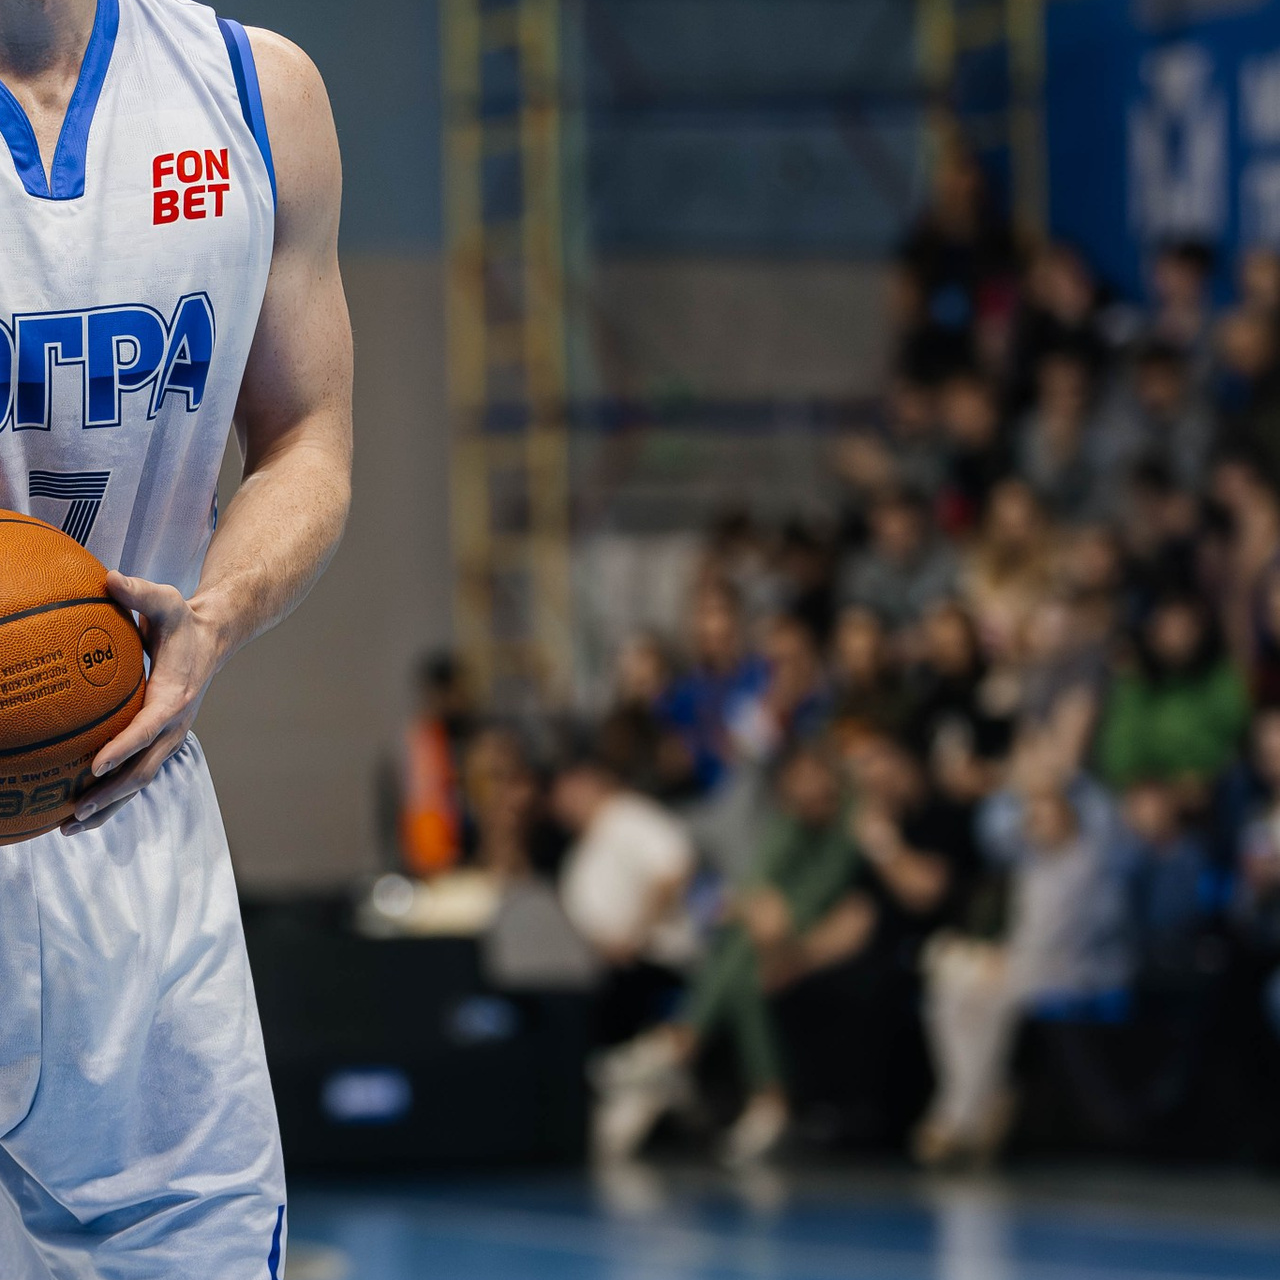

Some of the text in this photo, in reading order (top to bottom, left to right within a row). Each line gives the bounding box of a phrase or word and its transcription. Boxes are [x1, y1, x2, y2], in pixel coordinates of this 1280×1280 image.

[152, 148, 229, 188] FON
[152, 183, 230, 225] BET
[28, 469, 113, 549] 7
[83, 645, 114, 669] РФБ
